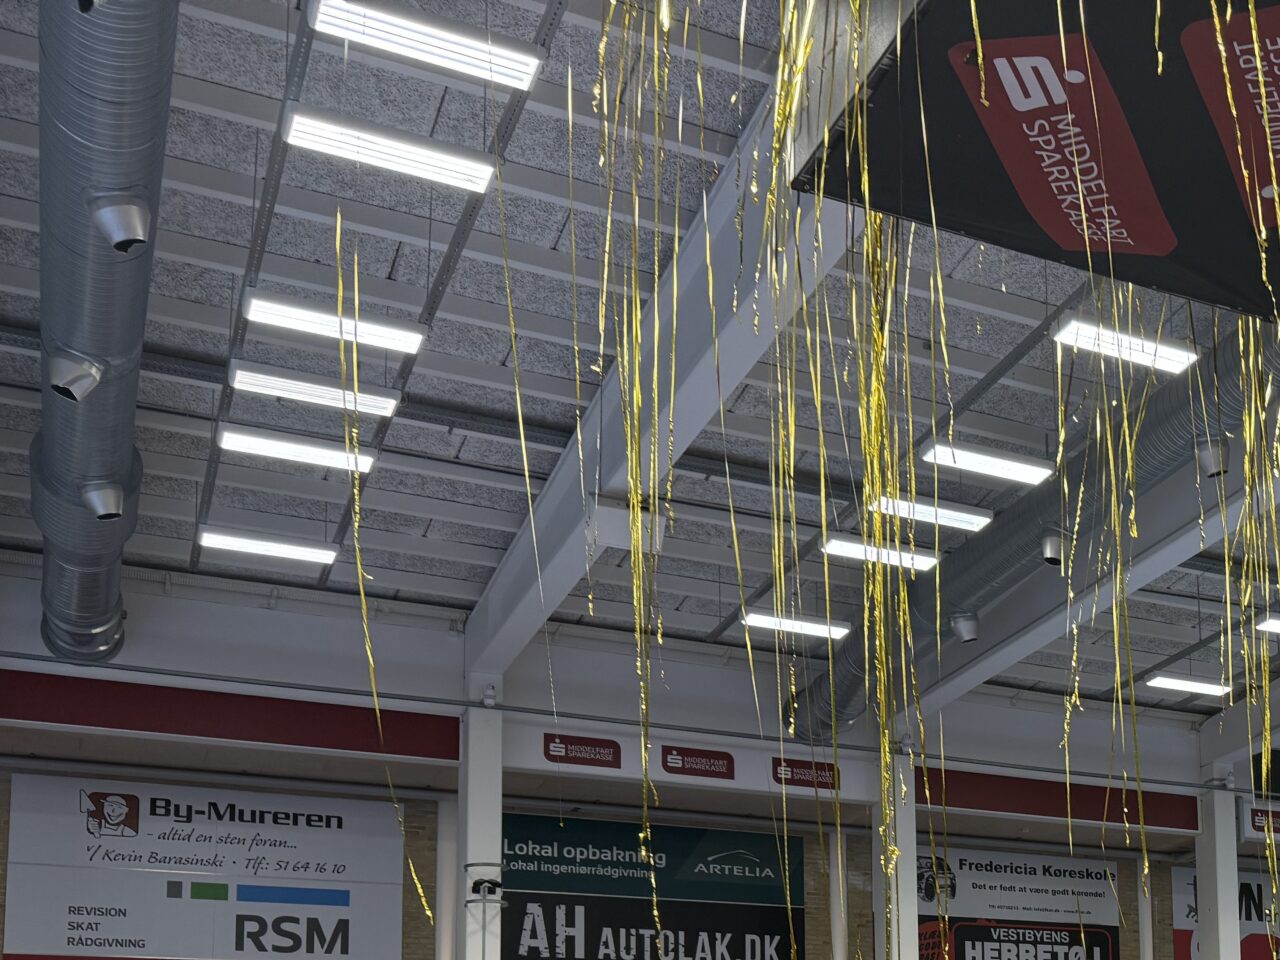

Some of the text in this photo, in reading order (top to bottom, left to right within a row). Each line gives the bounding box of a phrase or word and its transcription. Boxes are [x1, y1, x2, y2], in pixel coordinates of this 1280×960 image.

[1022, 119, 1107, 243] SPAREKASSE
[1051, 114, 1134, 247] MIDDELFART
[567, 745, 613, 754] MIDDELFART
[567, 750, 613, 761] SPAREKASSE
[684, 756, 728, 766] MIDDELFART
[684, 762, 728, 772] SPAREKASSE
[149, 797, 343, 830] By-Mureren
[157, 826, 193, 843] altid
[196, 832, 213, 844] en
[216, 832, 246, 847] sten
[248, 832, 297, 852] foran...
[503, 838, 667, 868] Lokal opbaknig
[101, 849, 143, 863] Kevin
[147, 851, 224, 868] Barasinski
[245, 856, 270, 876] Tlf.:
[273, 859, 290, 873] 51
[292, 860, 310, 873] 64
[314, 861, 328, 874] 16
[331, 863, 347, 875] 10
[540, 861, 656, 880] ingeniørrådgivning
[694, 863, 775, 878] ARTELIA
[958, 858, 1116, 882] Fredericia Køreskole
[971, 882, 986, 891] Det
[1018, 885, 1027, 893] at
[1051, 887, 1069, 897] godt
[68, 905, 127, 918] REVISION
[67, 920, 101, 932] SKAT
[518, 902, 585, 959] AH
[66, 935, 146, 949] RÅDGIVNING
[234, 914, 350, 956] RSM
[990, 928, 1070, 942] VESTBYENS
